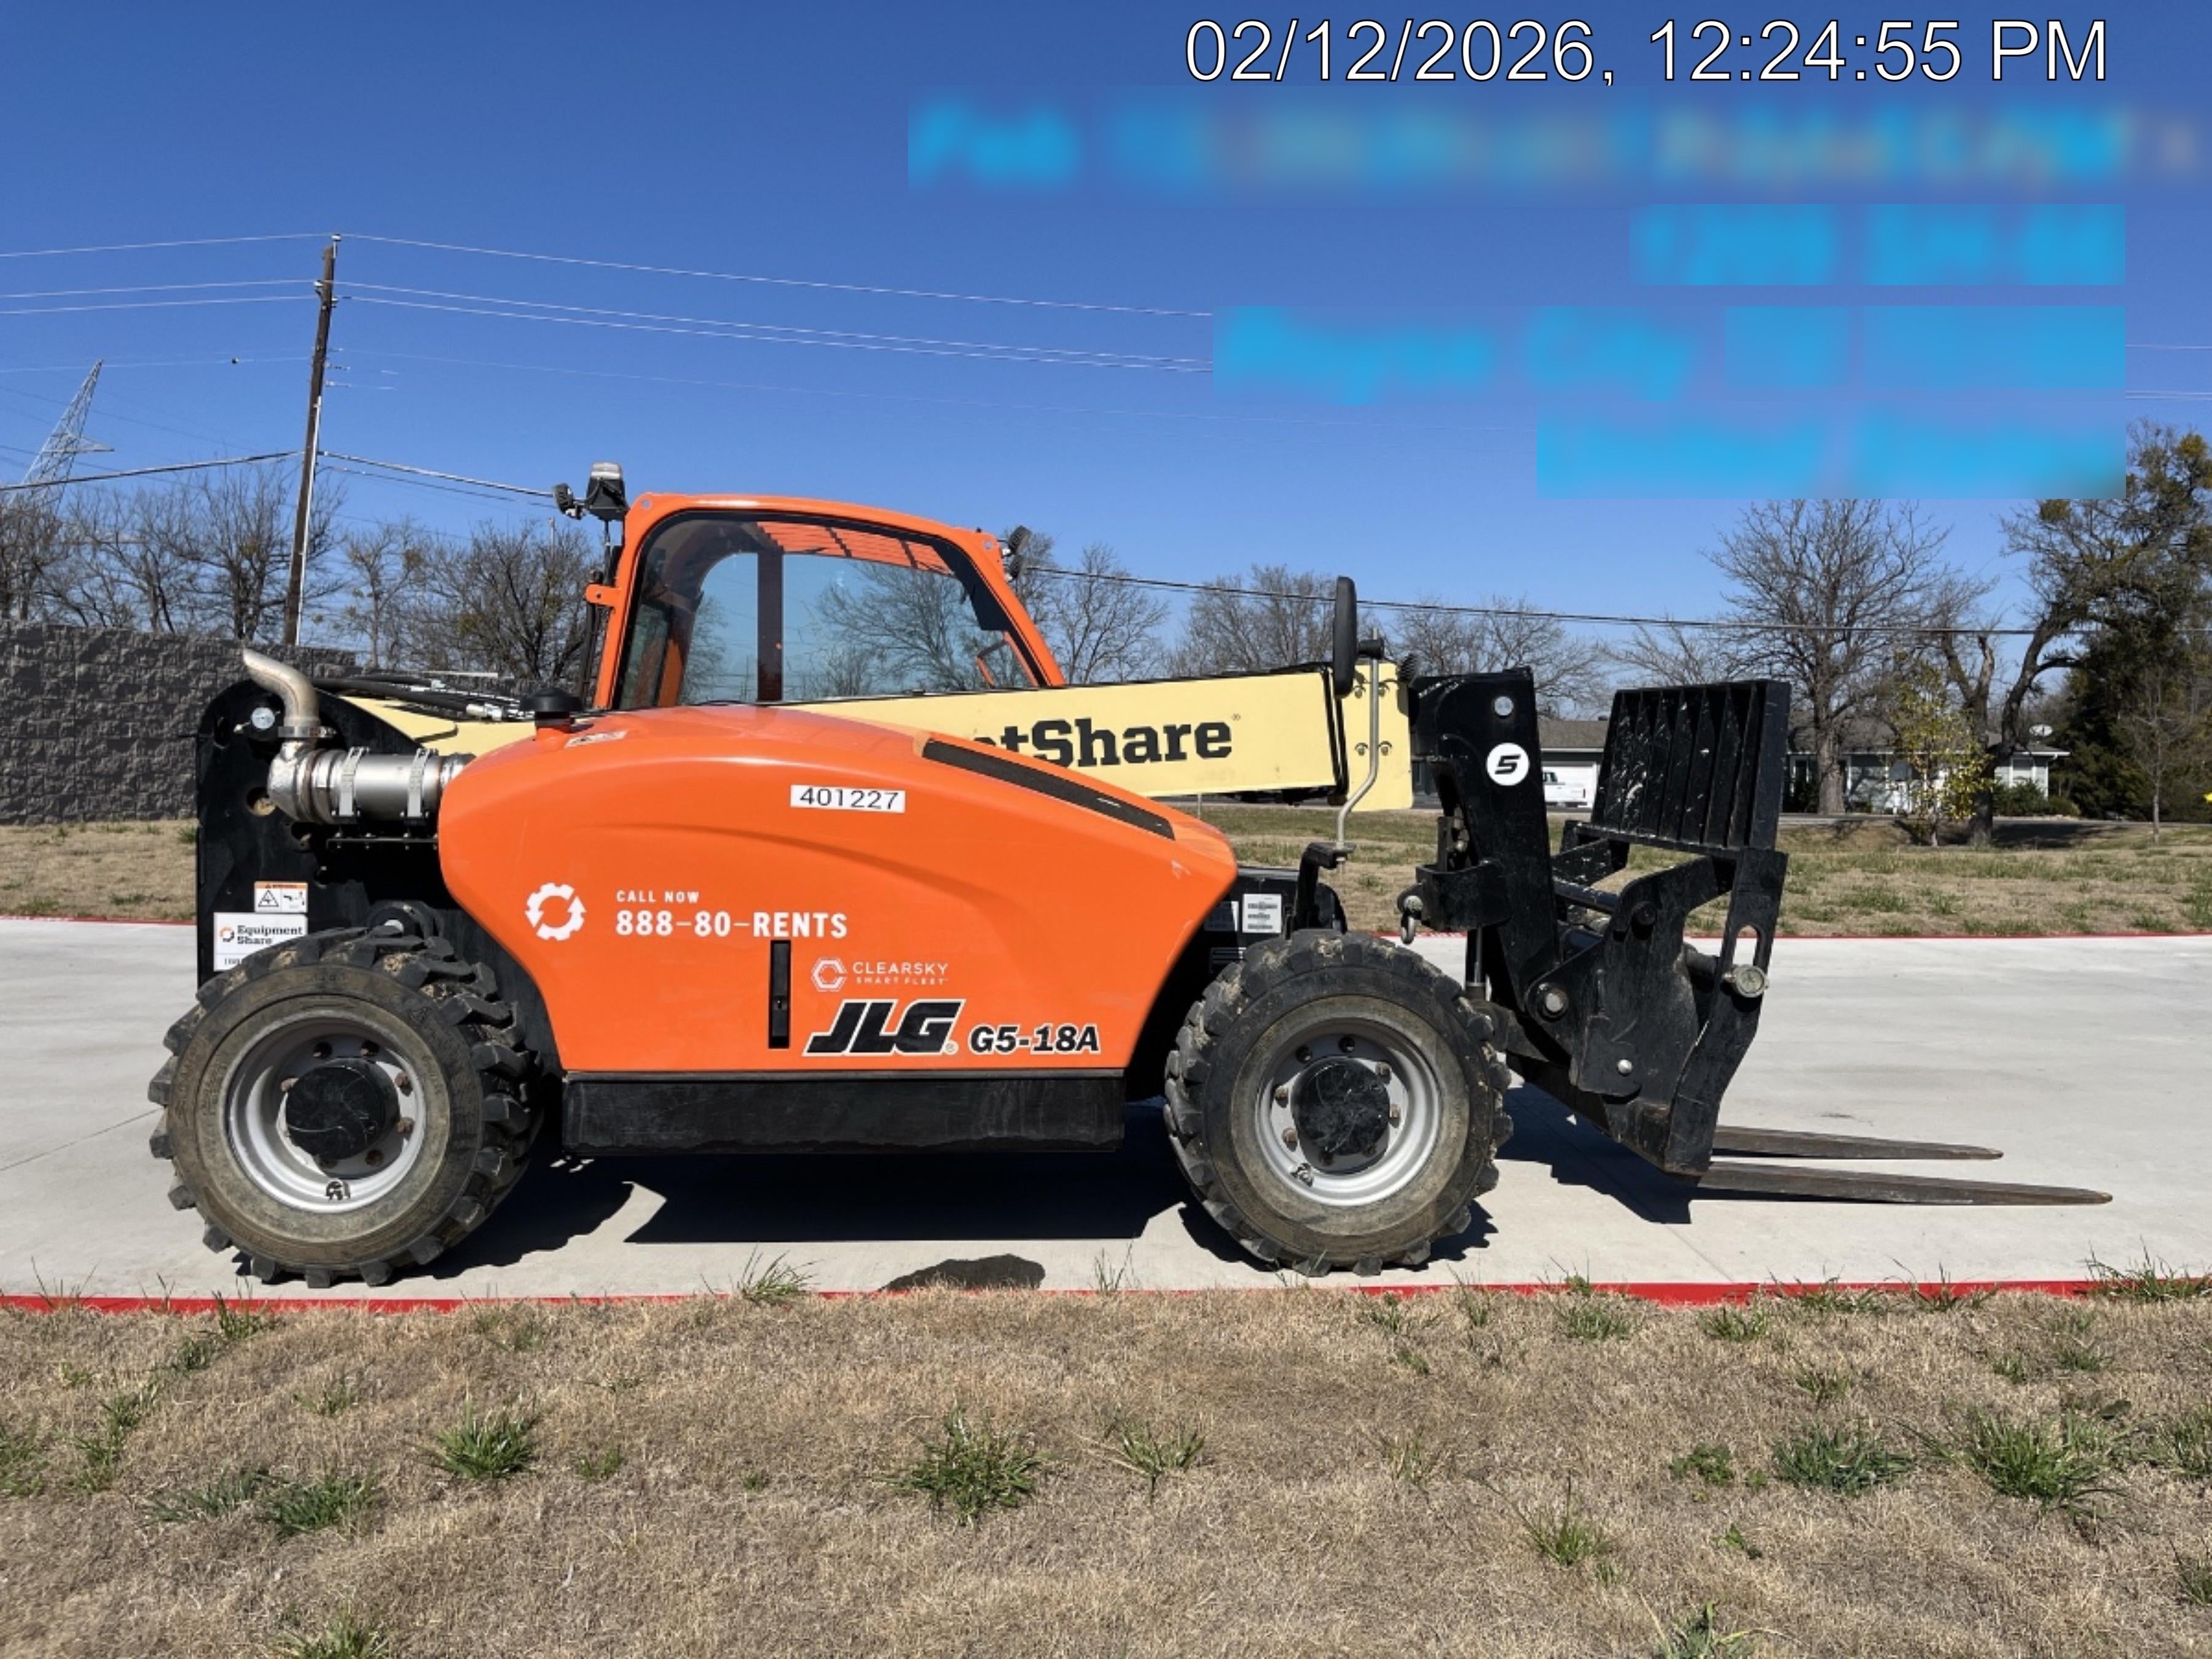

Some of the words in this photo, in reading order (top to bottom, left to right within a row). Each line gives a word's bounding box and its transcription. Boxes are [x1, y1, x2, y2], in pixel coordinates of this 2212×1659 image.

[973, 718, 1232, 767] tShare
[799, 786, 898, 809] 401227
[616, 890, 656, 903] CALL
[664, 891, 699, 904] NOW
[237, 925, 303, 936] Equipment
[616, 909, 847, 938] 888-80-RENTS
[237, 936, 272, 944] Share
[852, 962, 949, 975] CLEARSKY
[804, 1000, 965, 1055] JLG
[970, 1024, 1100, 1054] G5-18A
